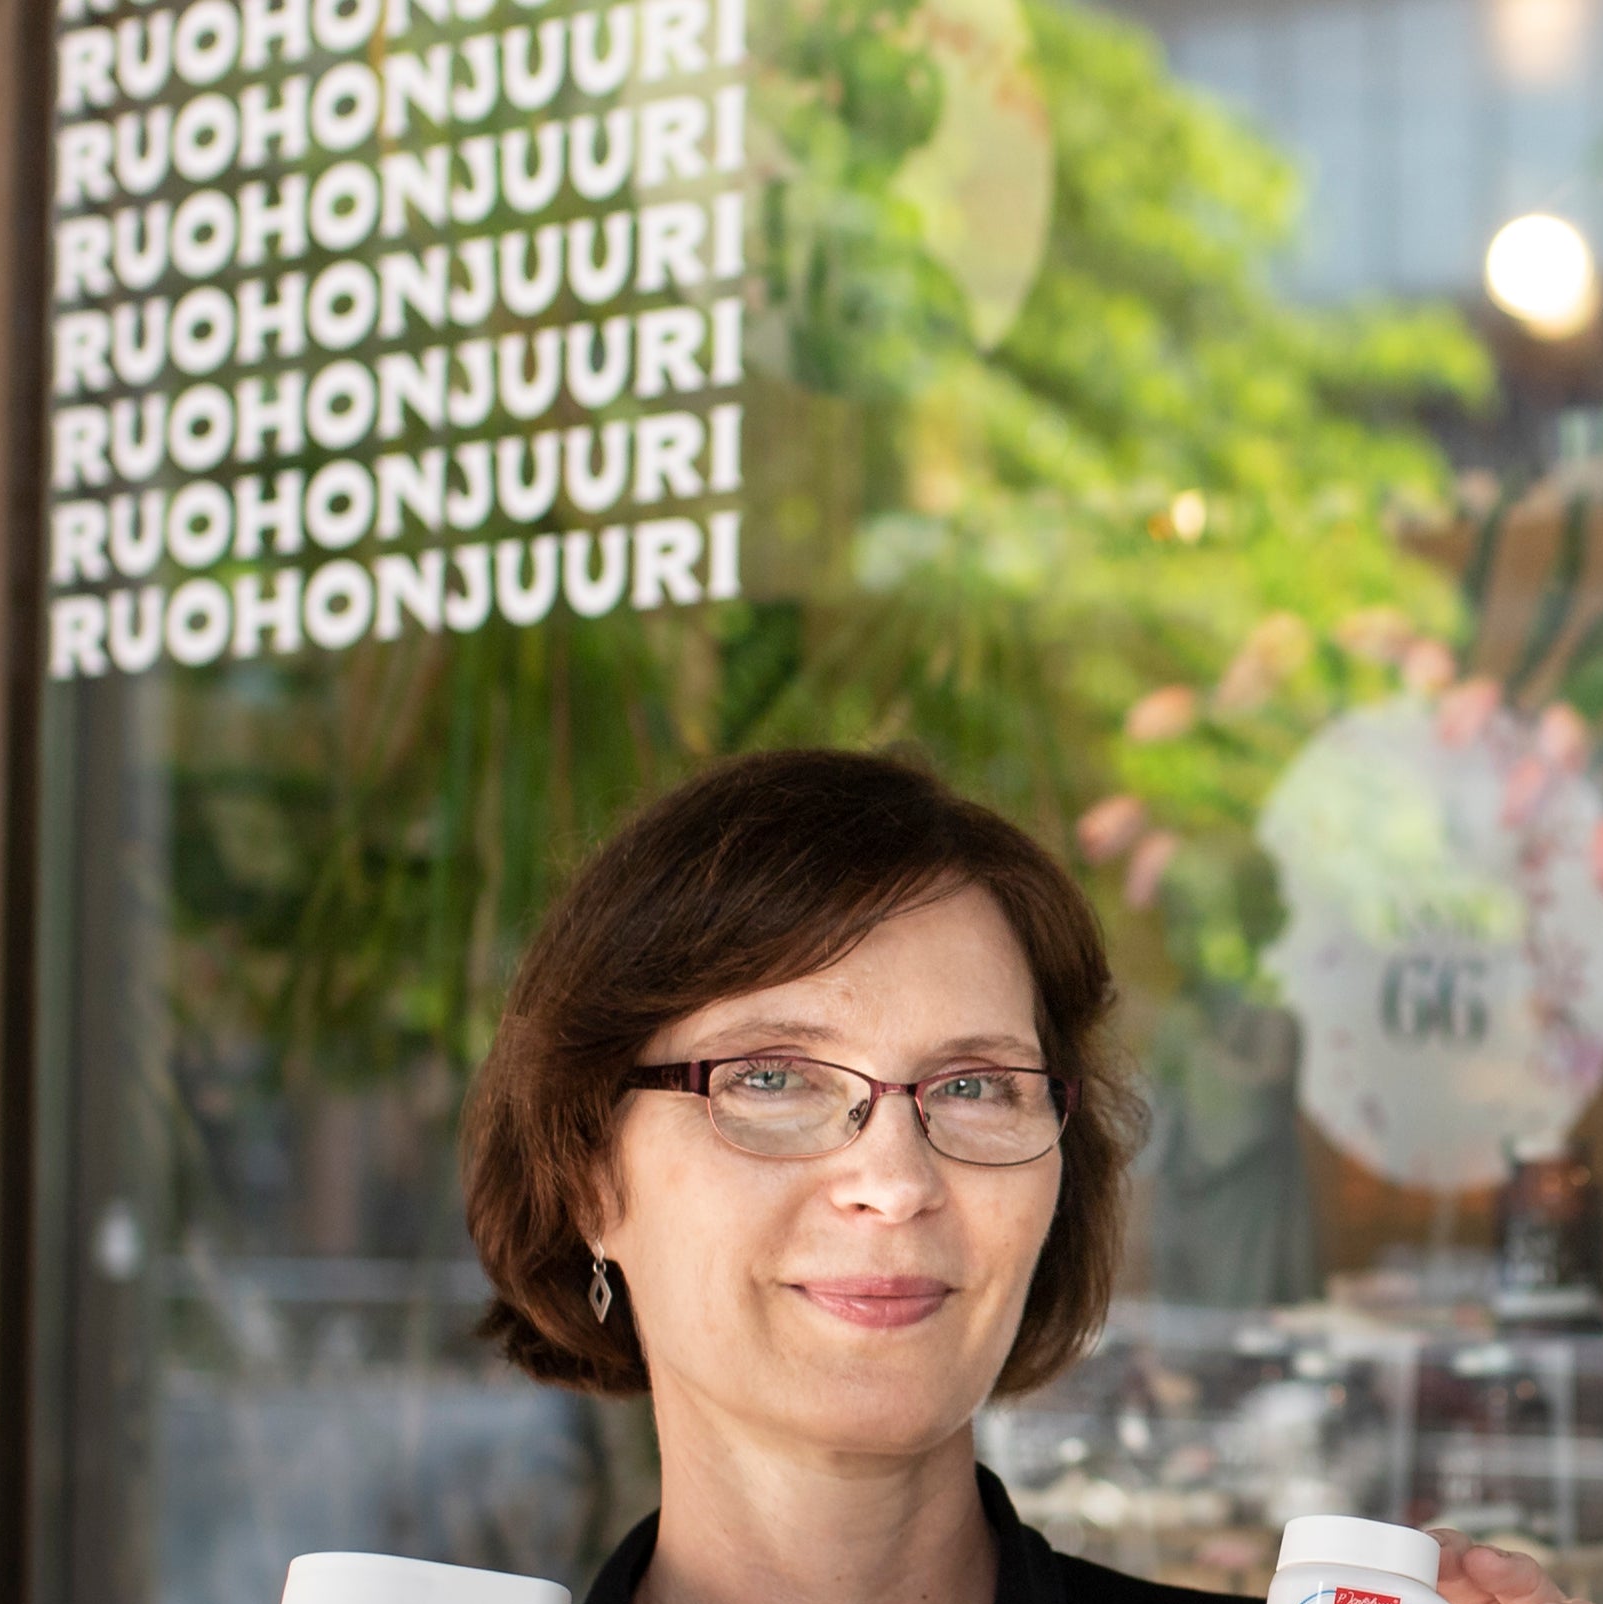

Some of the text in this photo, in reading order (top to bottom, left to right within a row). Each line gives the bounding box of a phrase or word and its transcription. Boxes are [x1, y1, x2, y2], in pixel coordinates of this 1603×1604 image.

[54, 87, 744, 301] RUOHONJUURI
[55, 0, 745, 206] RUOHONJUURI
[52, 194, 743, 397] RUOHONJUURI
[50, 403, 742, 584] RUOHONJUURI
[51, 299, 743, 491] RUOHONJUURI
[49, 511, 740, 680] RUOHONJUURI
